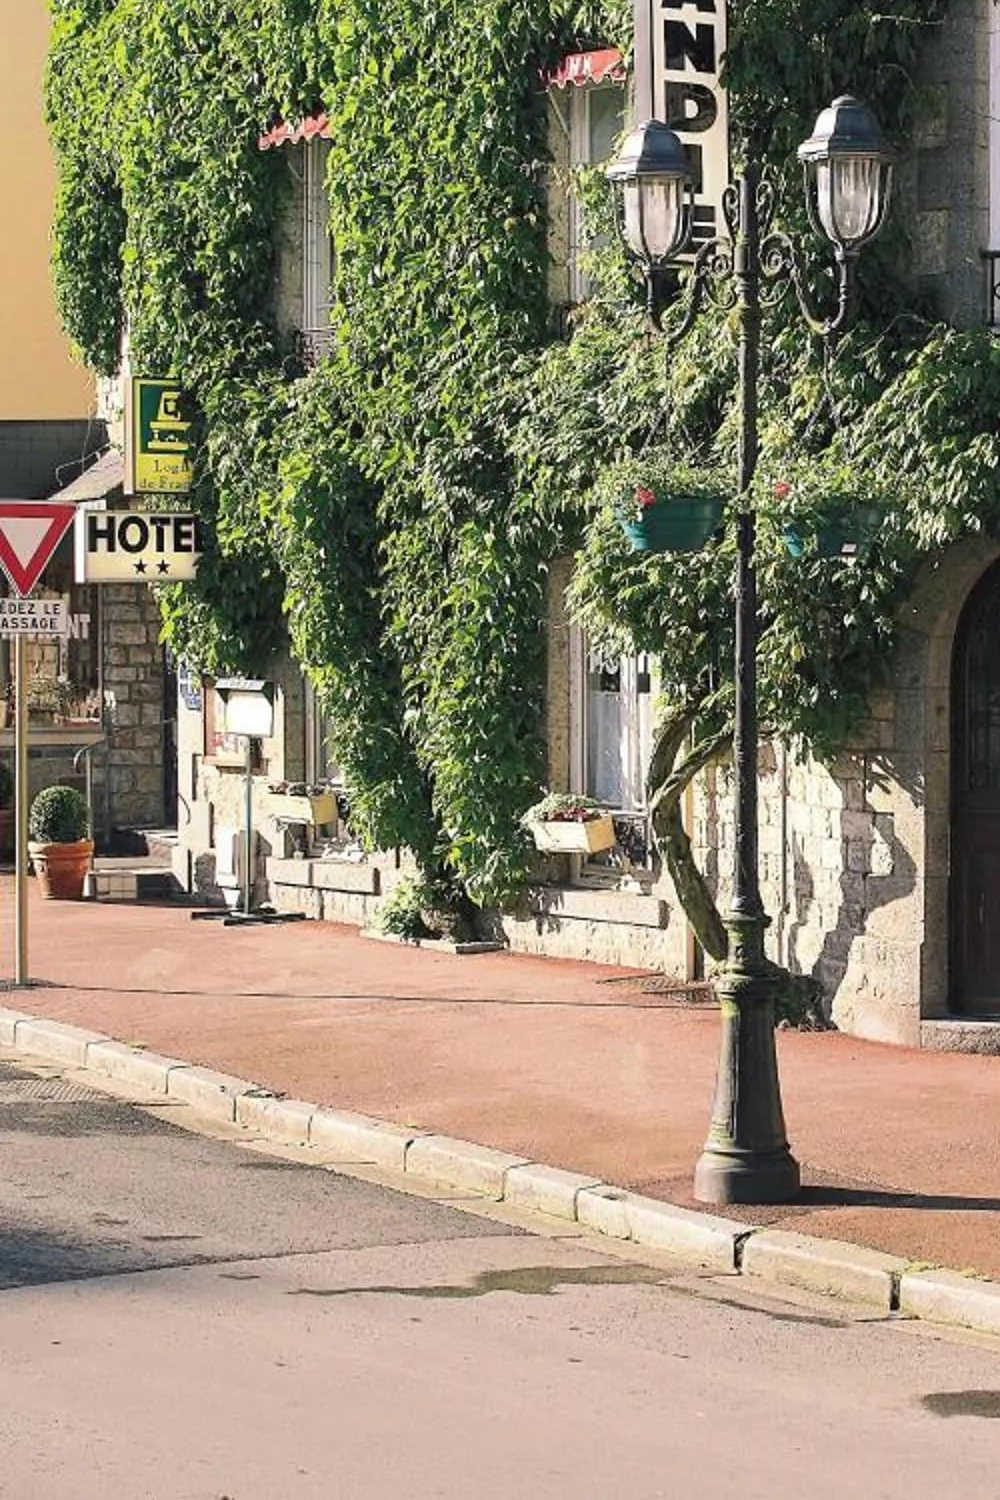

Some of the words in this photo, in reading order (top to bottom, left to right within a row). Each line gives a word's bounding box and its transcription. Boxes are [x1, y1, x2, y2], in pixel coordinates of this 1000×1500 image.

[0, 600, 36, 615] ÉDEZ
[44, 603, 61, 615] LE
[0, 617, 58, 630] ASSAGE
